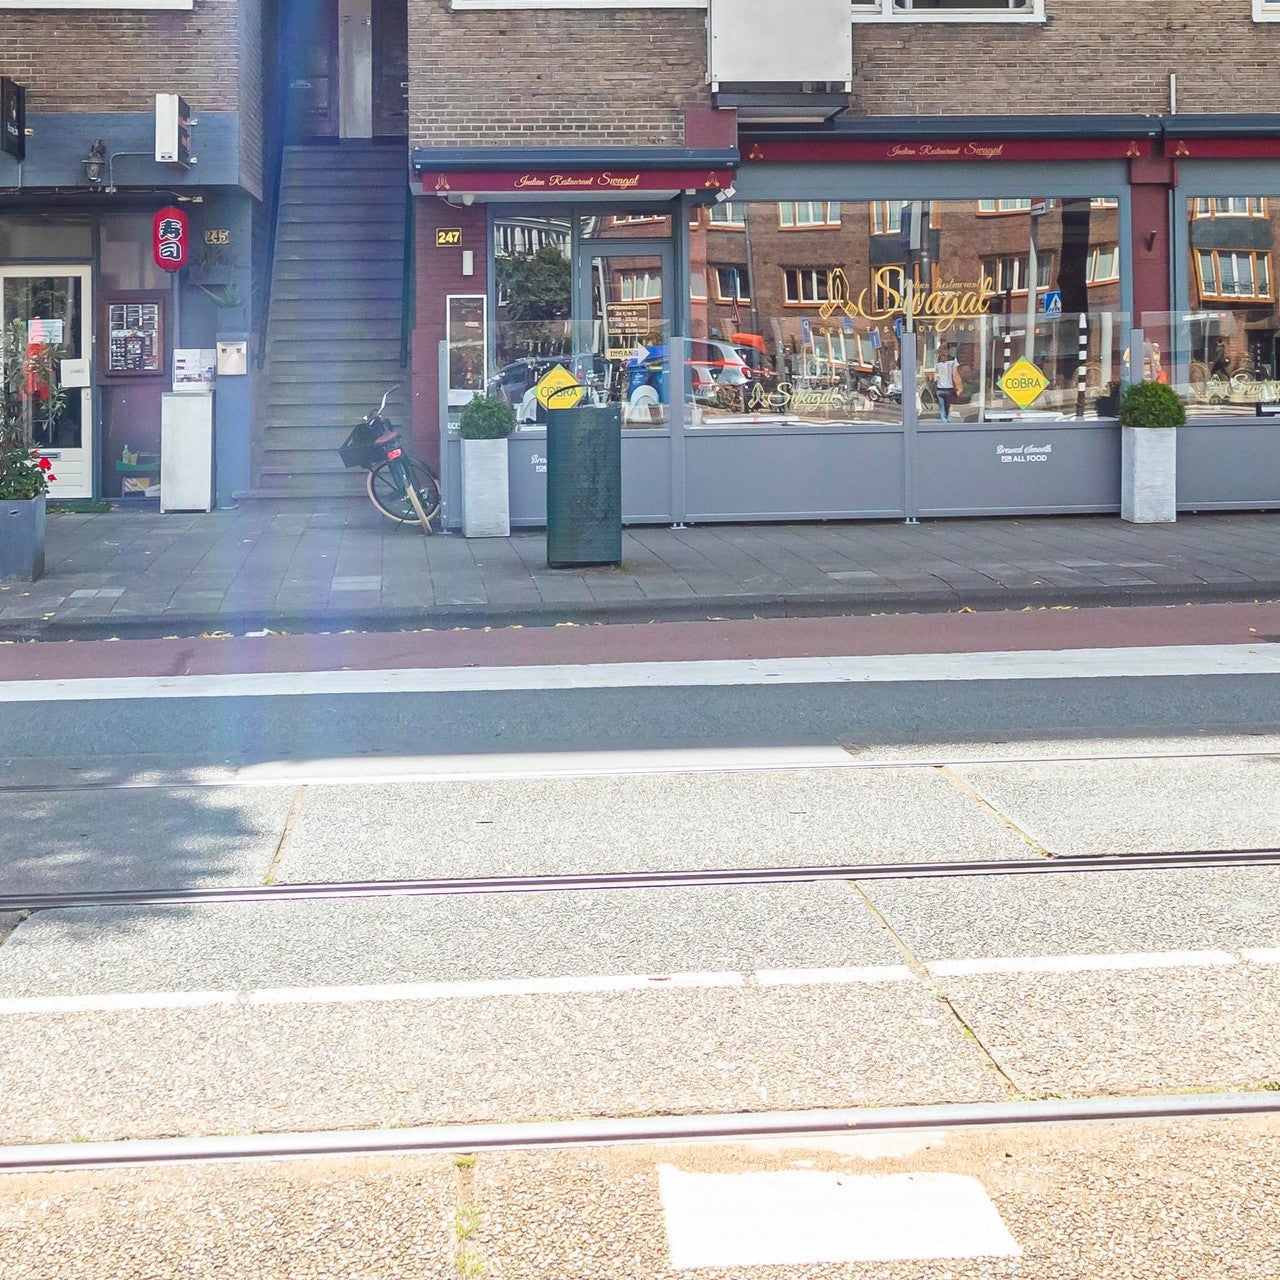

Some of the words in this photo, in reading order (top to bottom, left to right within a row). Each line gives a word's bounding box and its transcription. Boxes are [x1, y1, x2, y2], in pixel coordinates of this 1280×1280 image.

[886, 144, 916, 157] Indian
[919, 144, 961, 155] Restaurant
[963, 142, 1004, 159] Swagat
[513, 174, 545, 188] Indian
[548, 174, 594, 186] Restaurant
[597, 172, 640, 190] Swagat
[207, 231, 228, 243] 245
[438, 231, 460, 243] 247
[858, 265, 993, 333] Swagat
[1005, 378, 1041, 390] COBRA
[540, 386, 578, 398] COBRA
[1026, 454, 1048, 462] FOOD
